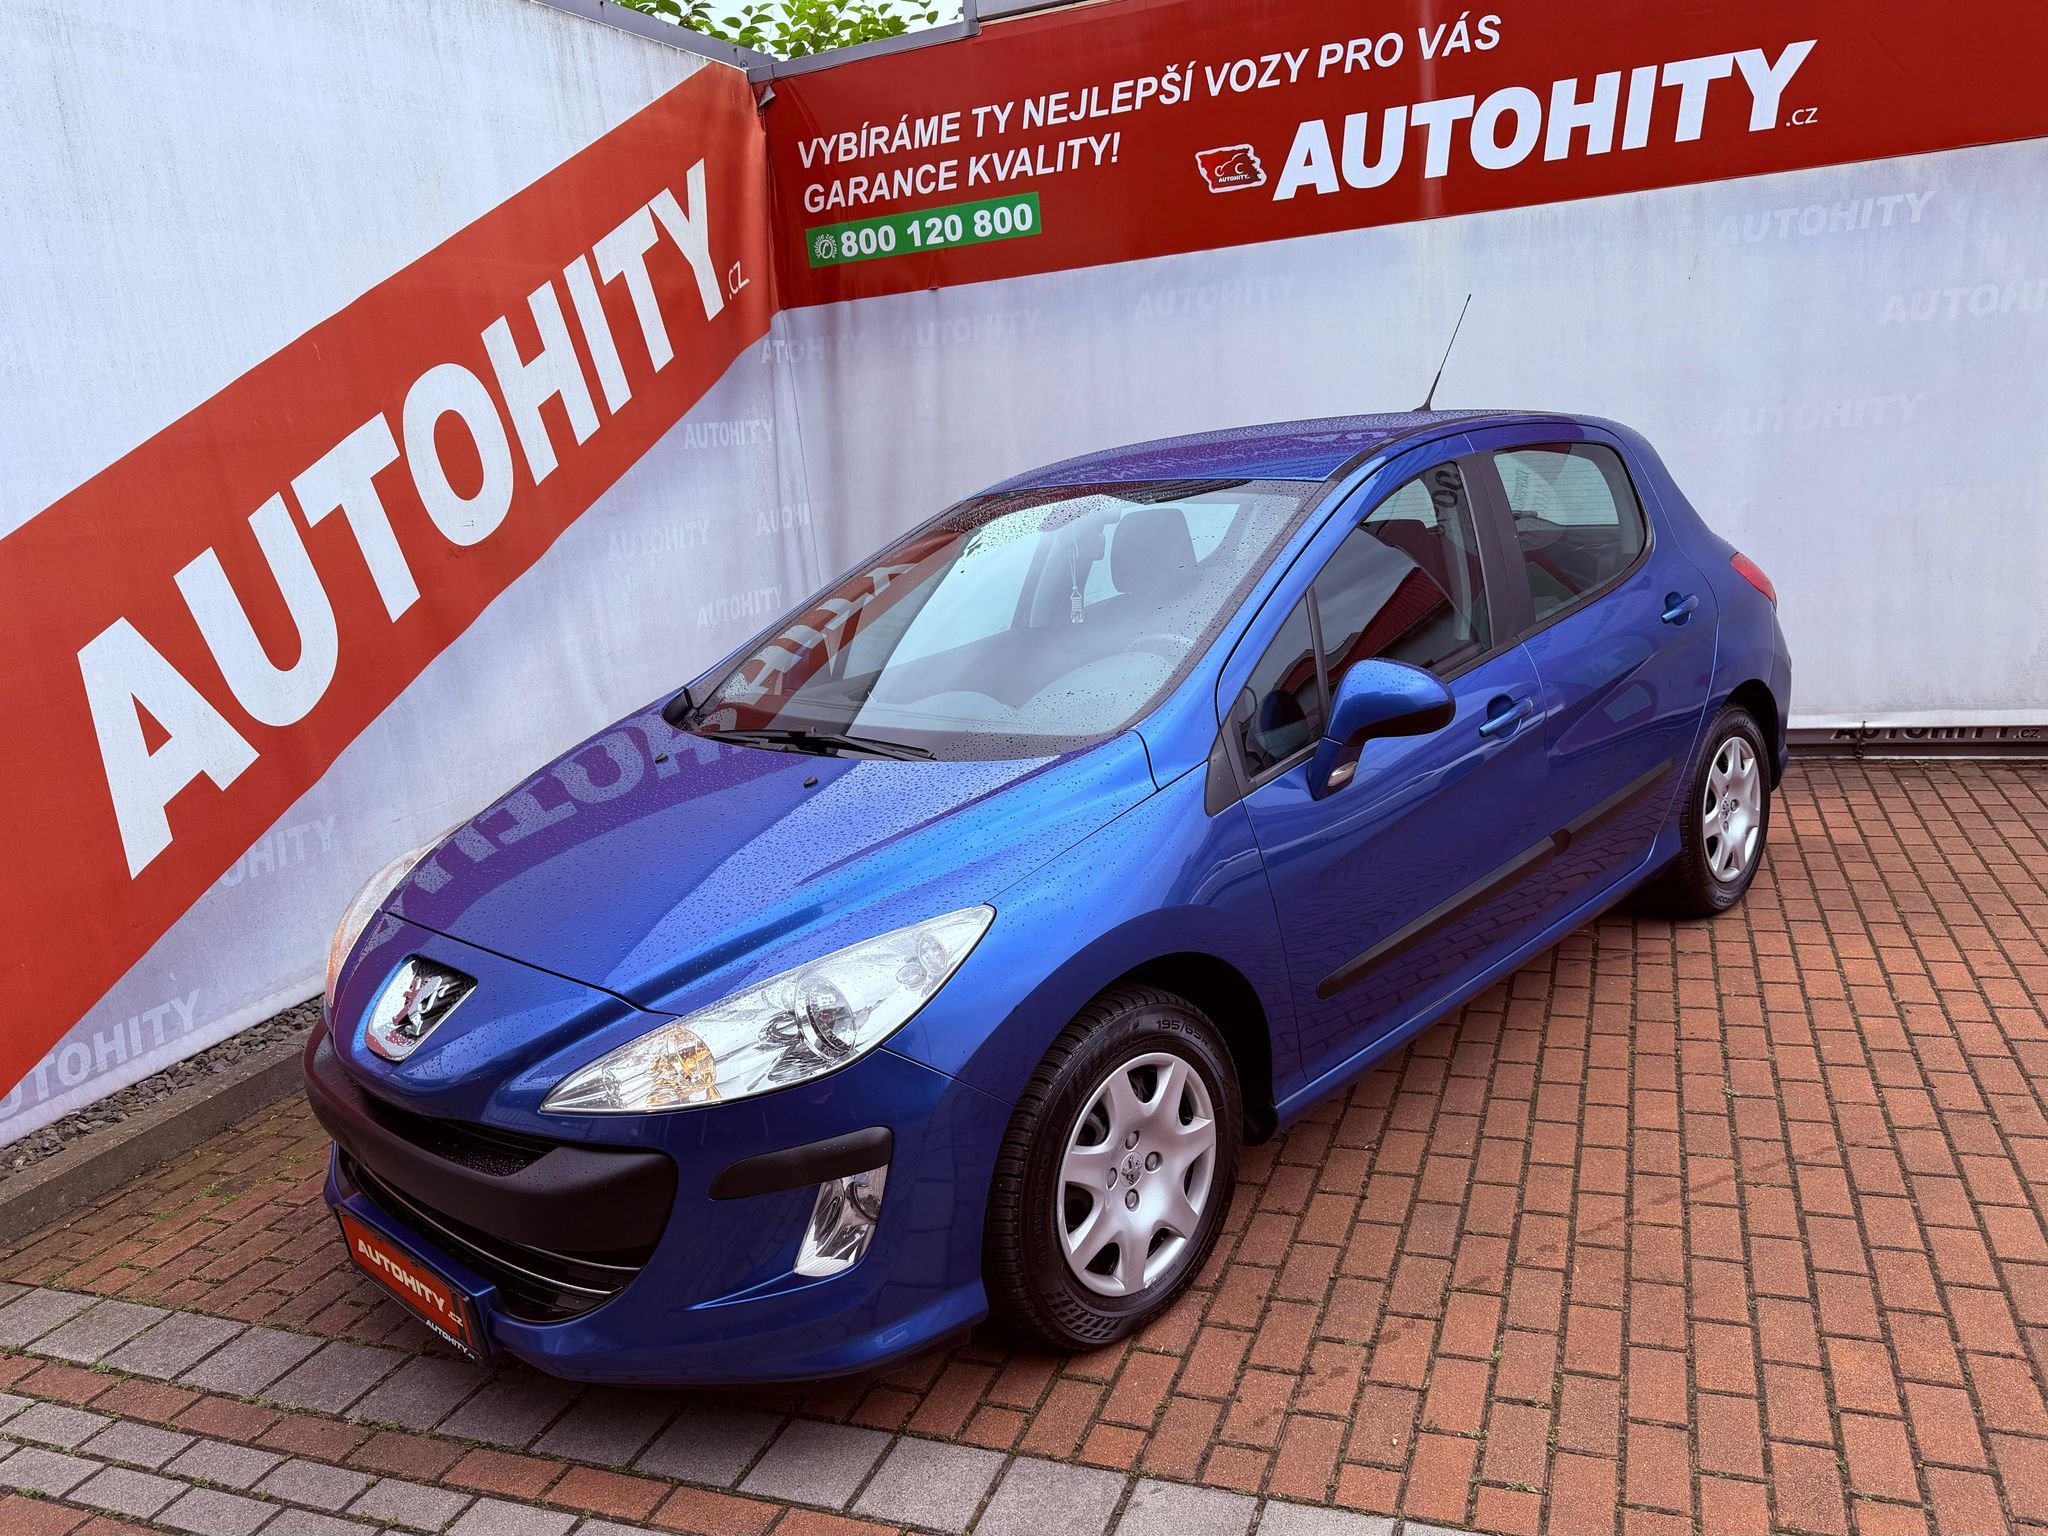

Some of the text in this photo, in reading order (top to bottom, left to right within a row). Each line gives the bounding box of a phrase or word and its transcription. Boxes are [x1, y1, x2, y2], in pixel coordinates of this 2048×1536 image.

[798, 11, 1502, 169] VYBÍRÁME TY NEJLEPŠÍ VOZY PRO VÁS
[803, 131, 1121, 213] GARANCE KVALITY!
[840, 203, 1033, 258] 800 120 800
[1715, 190, 1935, 248] AUTOHITY
[684, 418, 774, 450] AUTOHITY
[698, 585, 783, 630] AUTOHITY
